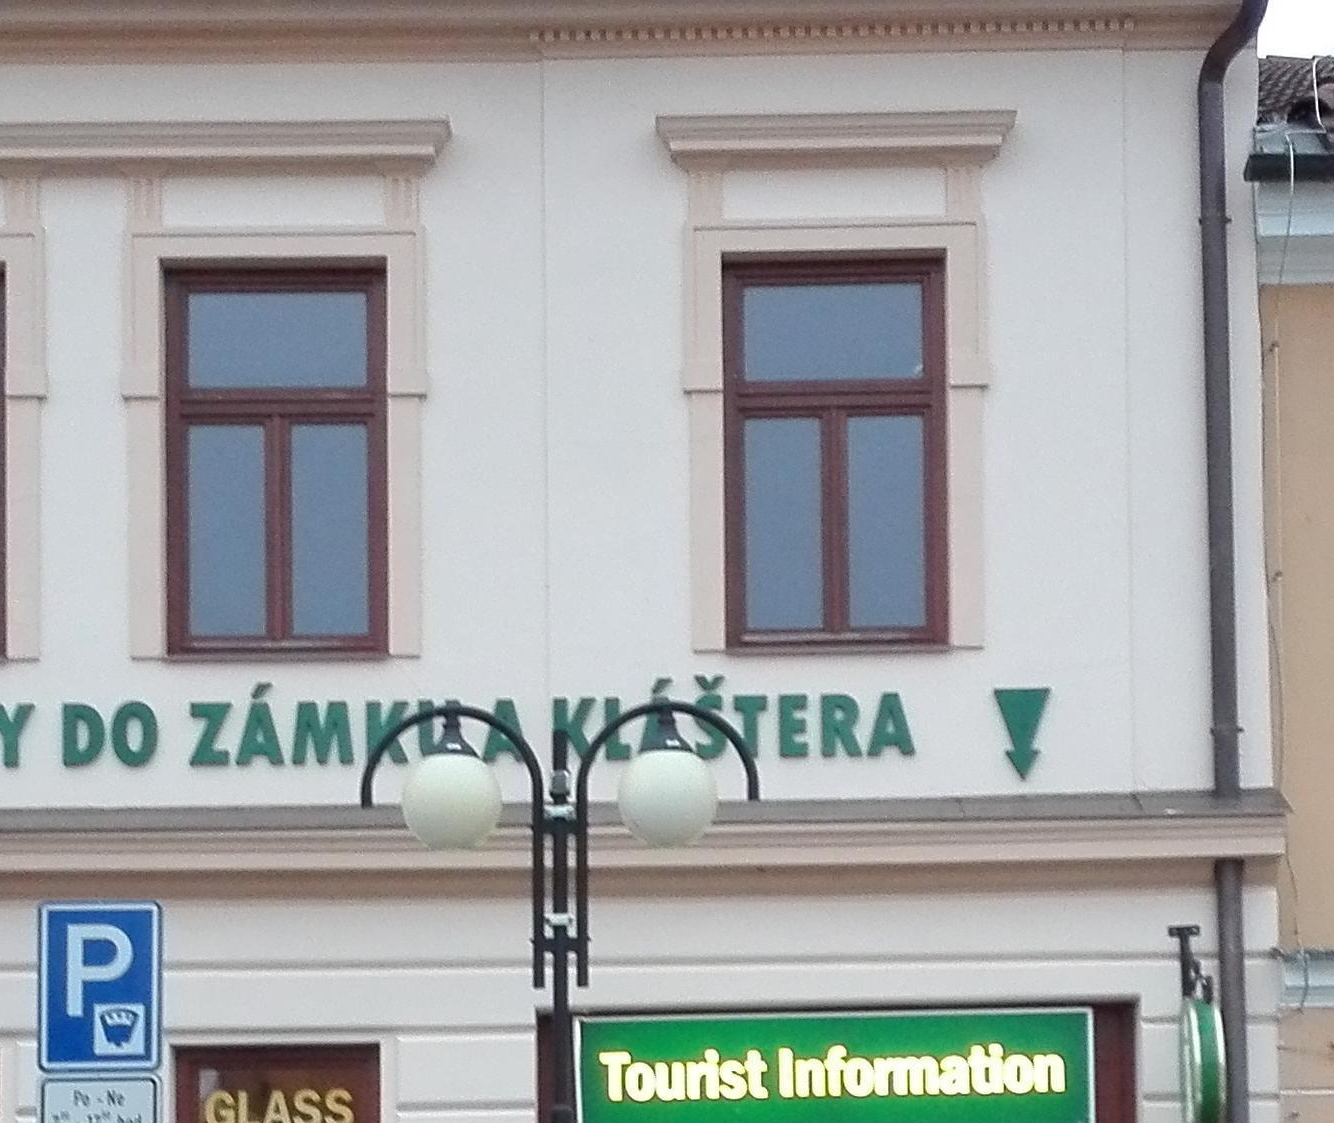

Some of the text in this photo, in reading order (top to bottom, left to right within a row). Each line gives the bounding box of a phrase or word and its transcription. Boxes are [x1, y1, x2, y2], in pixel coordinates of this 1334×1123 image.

[63, 701, 158, 768] DO
[483, 697, 525, 763] A
[553, 675, 916, 762] KLÁŠTERA
[67, 923, 133, 1018] P
[73, 1089, 90, 1107] Po
[106, 1089, 126, 1107] Ne
[598, 1042, 1066, 1102] Tourist Information
